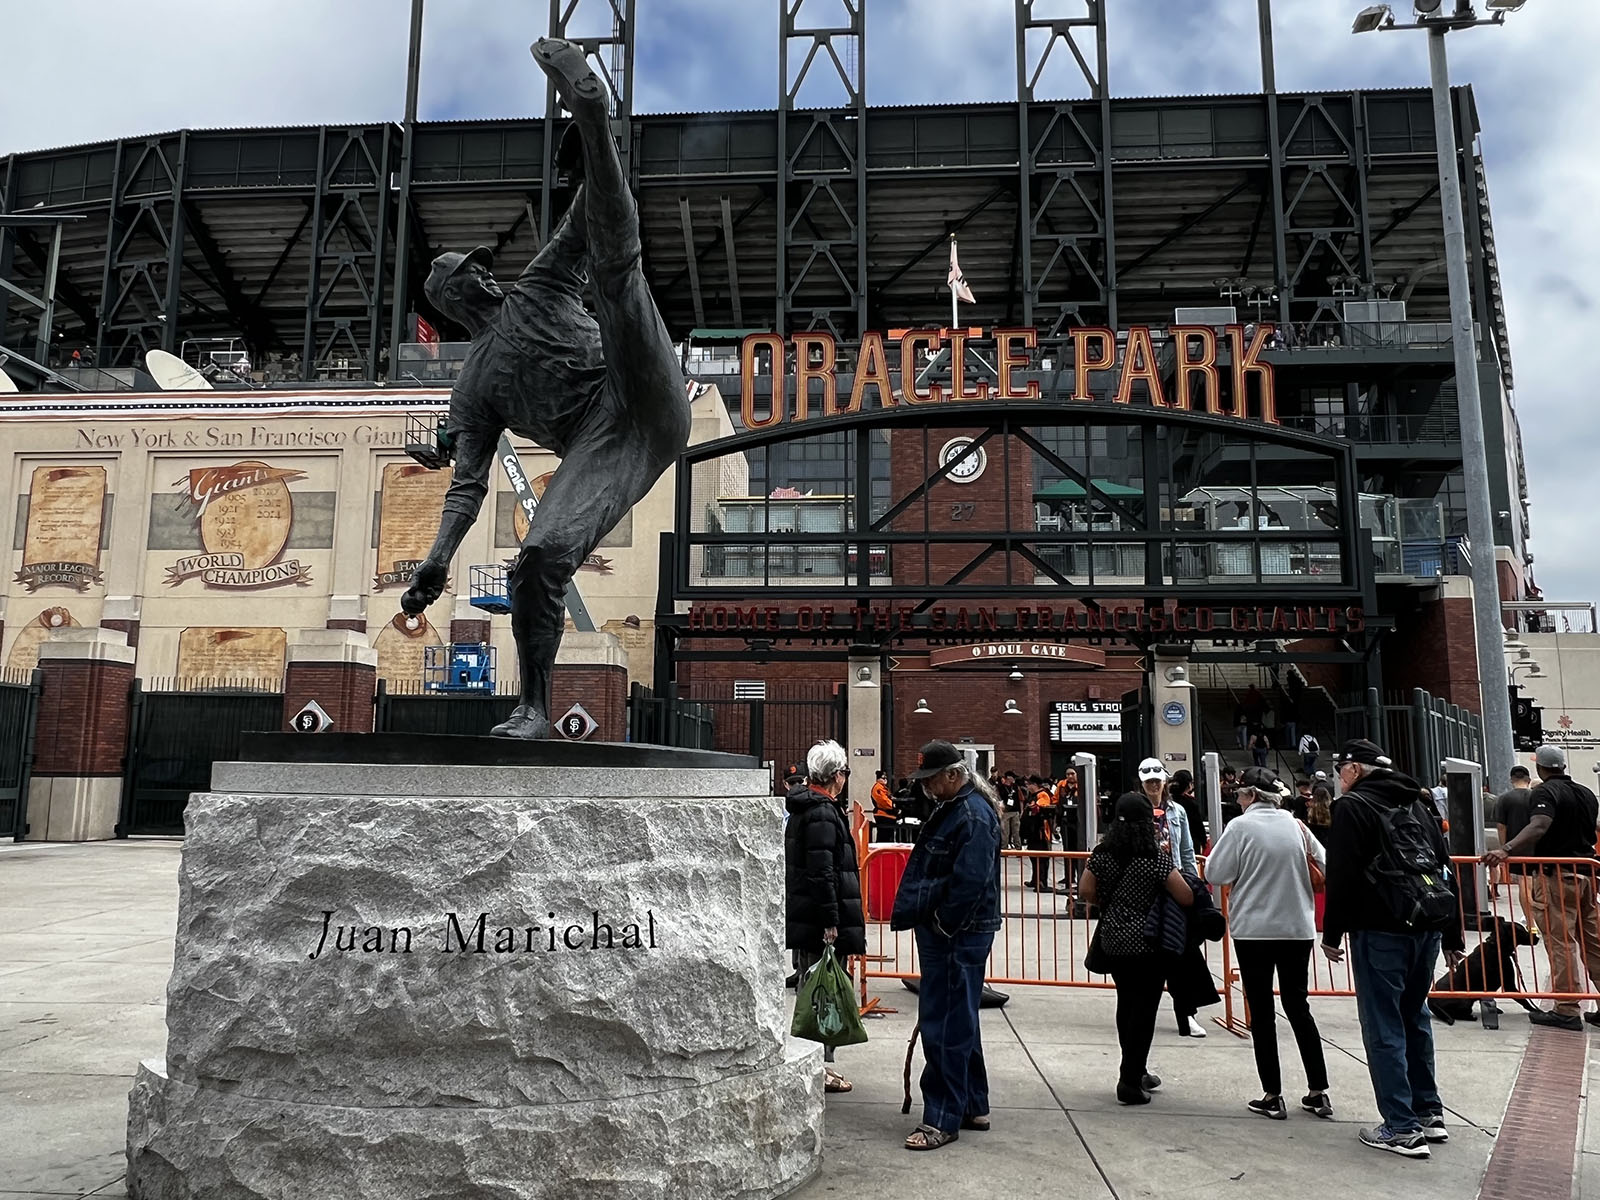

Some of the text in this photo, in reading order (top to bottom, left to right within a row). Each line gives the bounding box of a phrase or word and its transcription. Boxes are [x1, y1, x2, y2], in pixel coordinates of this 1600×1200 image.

[740, 324, 1281, 431] ORACLE PARK
[75, 424, 404, 449] New York & San Francisco Gian
[503, 454, 526, 495] Genie
[193, 469, 269, 519] Giants
[951, 502, 976, 521] 27
[25, 562, 95, 575] MAJOR LEAGUE
[180, 554, 241, 572] WORLD
[203, 561, 299, 584] CHAMPIONS
[37, 573, 79, 584] RECORDS
[688, 606, 1365, 632] HOME OF THE SAN FRANCISCO GIANTS
[972, 644, 1066, 657] O'DOUL GATE
[1066, 723, 1104, 731] WELCOME
[1568, 729, 1592, 737] Health
[308, 910, 658, 960] Juan Marichal
